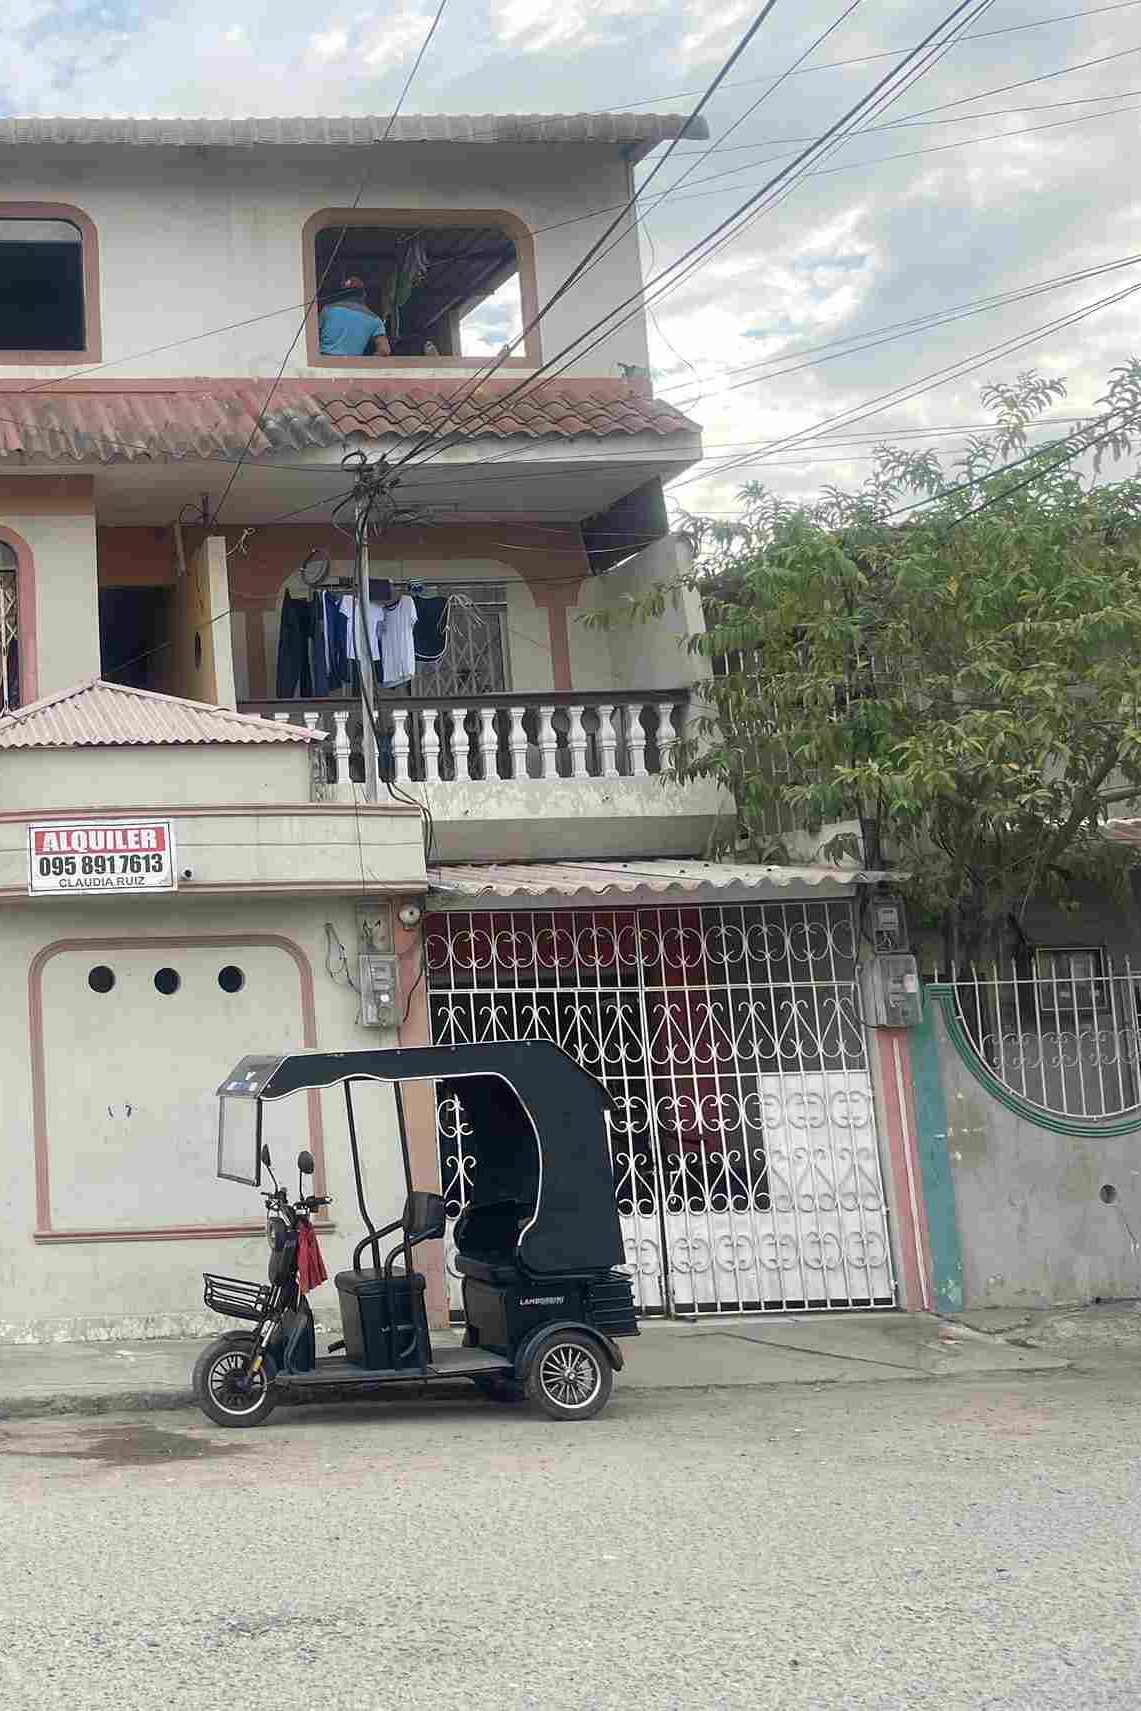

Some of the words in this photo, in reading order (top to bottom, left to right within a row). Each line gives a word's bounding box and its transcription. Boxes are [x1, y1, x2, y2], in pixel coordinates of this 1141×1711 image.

[43, 829, 156, 852] ALQUILER
[39, 856, 77, 876] 095
[82, 855, 115, 874] 891
[119, 854, 163, 873] 7613
[59, 877, 113, 888] CLAUDIA
[117, 876, 145, 886] RUIZ
